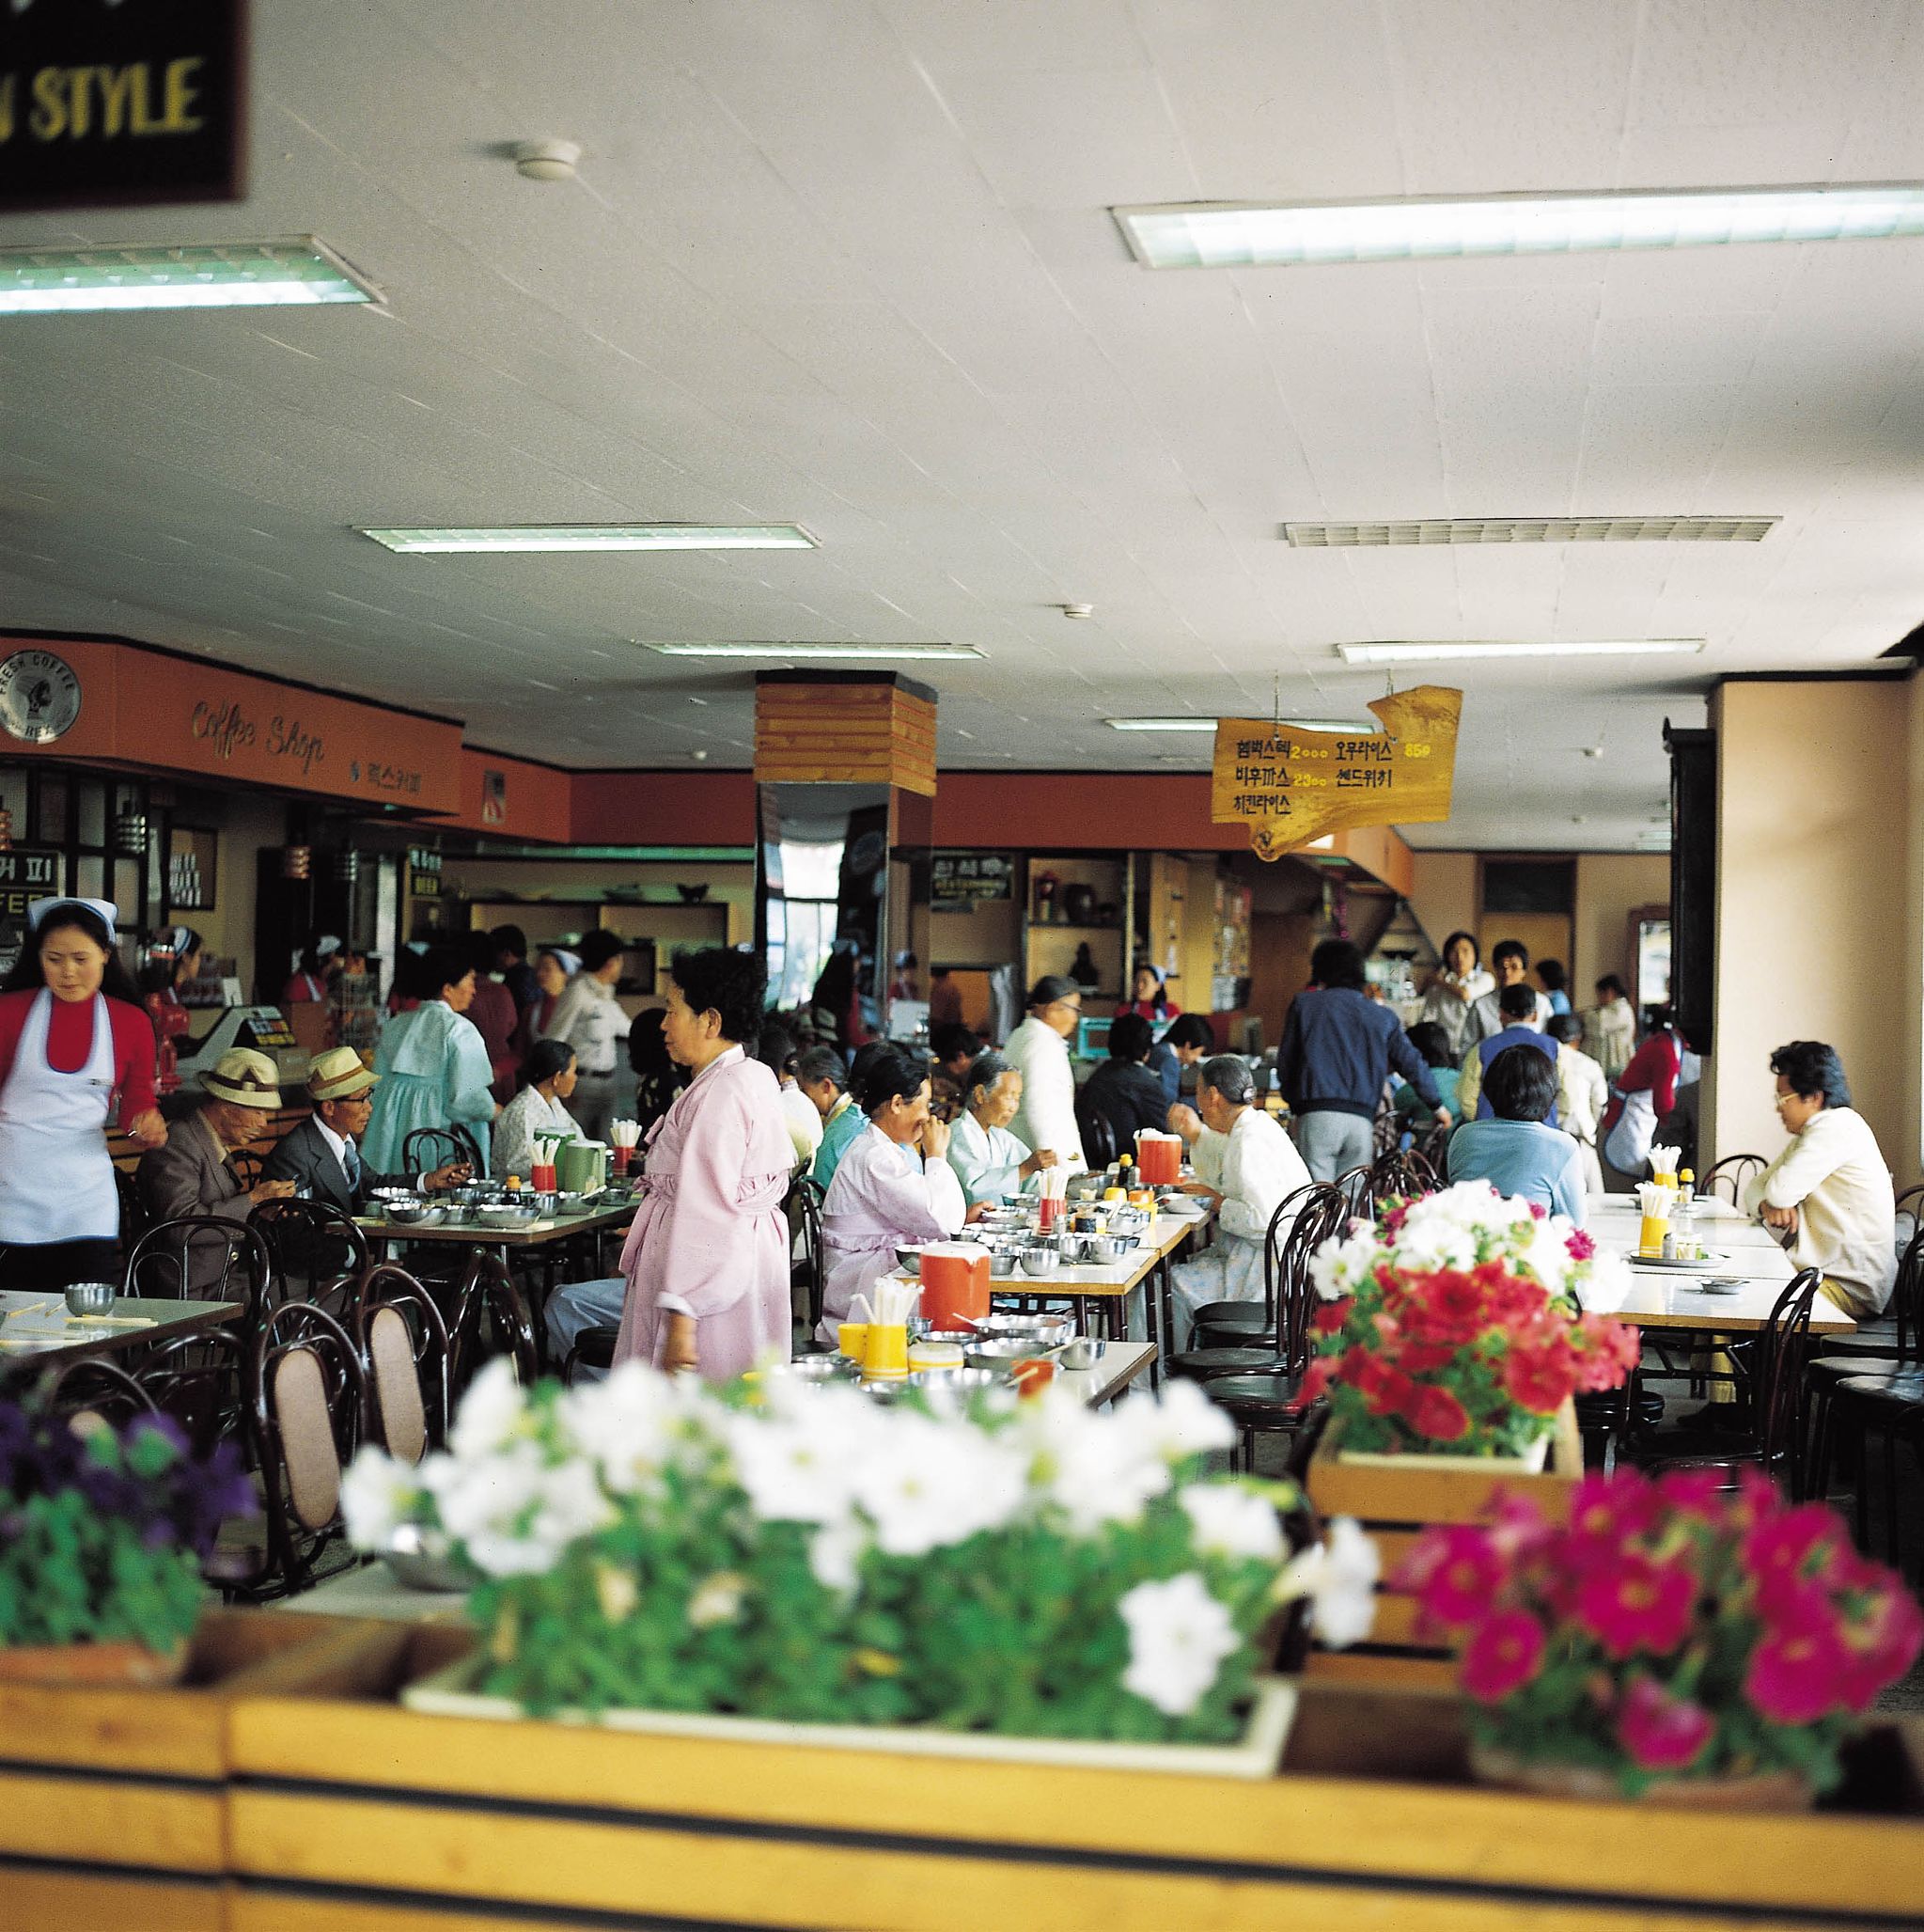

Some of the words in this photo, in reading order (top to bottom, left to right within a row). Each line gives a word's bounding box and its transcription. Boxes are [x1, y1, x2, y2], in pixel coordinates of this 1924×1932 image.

[29, 56, 206, 143] STYLE
[33, 654, 75, 690] COFFEE
[192, 699, 256, 760] Coffee
[266, 715, 325, 775] Shop
[1290, 746, 1329, 760] 2000
[1336, 741, 1393, 762] 오무라이스
[1235, 765, 1290, 787] 비후까스
[1233, 794, 1291, 815] 치킨라이스
